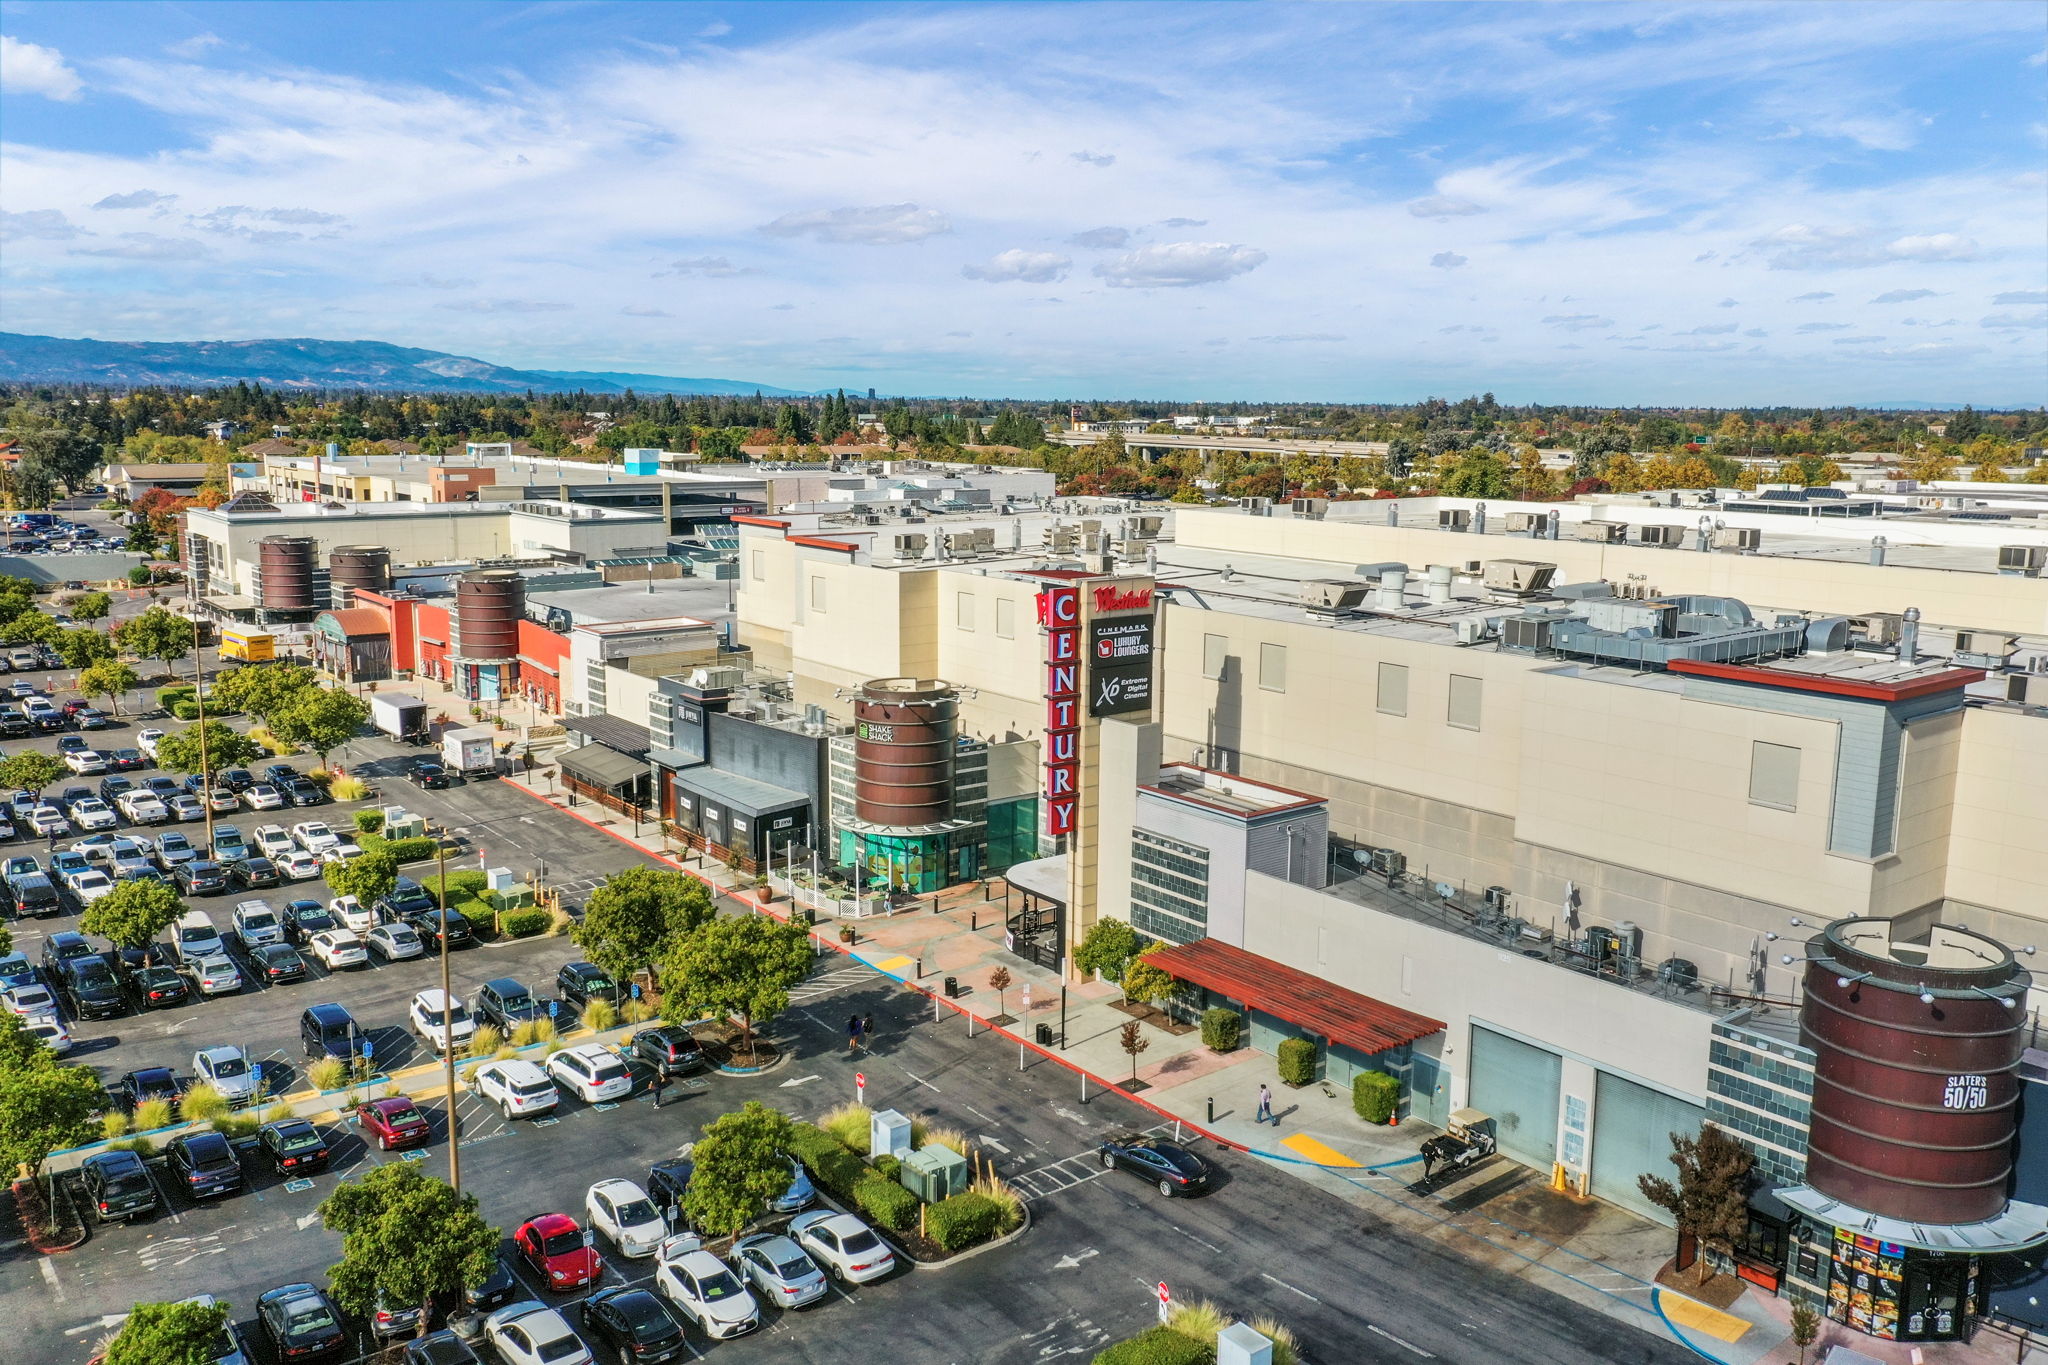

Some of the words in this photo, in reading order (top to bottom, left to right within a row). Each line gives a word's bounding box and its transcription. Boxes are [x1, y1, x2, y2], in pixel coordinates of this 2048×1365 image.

[1093, 586, 1153, 613] Westfield
[1097, 624, 1149, 635] CINEMARK
[1114, 635, 1141, 647] LUXURY
[1113, 644, 1149, 657] LOUNGERS
[1121, 677, 1148, 685] Extreme
[1096, 677, 1120, 707] XD
[1127, 684, 1148, 692] Digital
[1123, 692, 1148, 700] Cinema
[1054, 594, 1076, 829] CENTURY
[868, 724, 893, 734] SHAKE
[868, 732, 893, 742] SHACK
[1948, 1075, 1987, 1087] SLATER'S
[1944, 1086, 1987, 1110] 50/50
